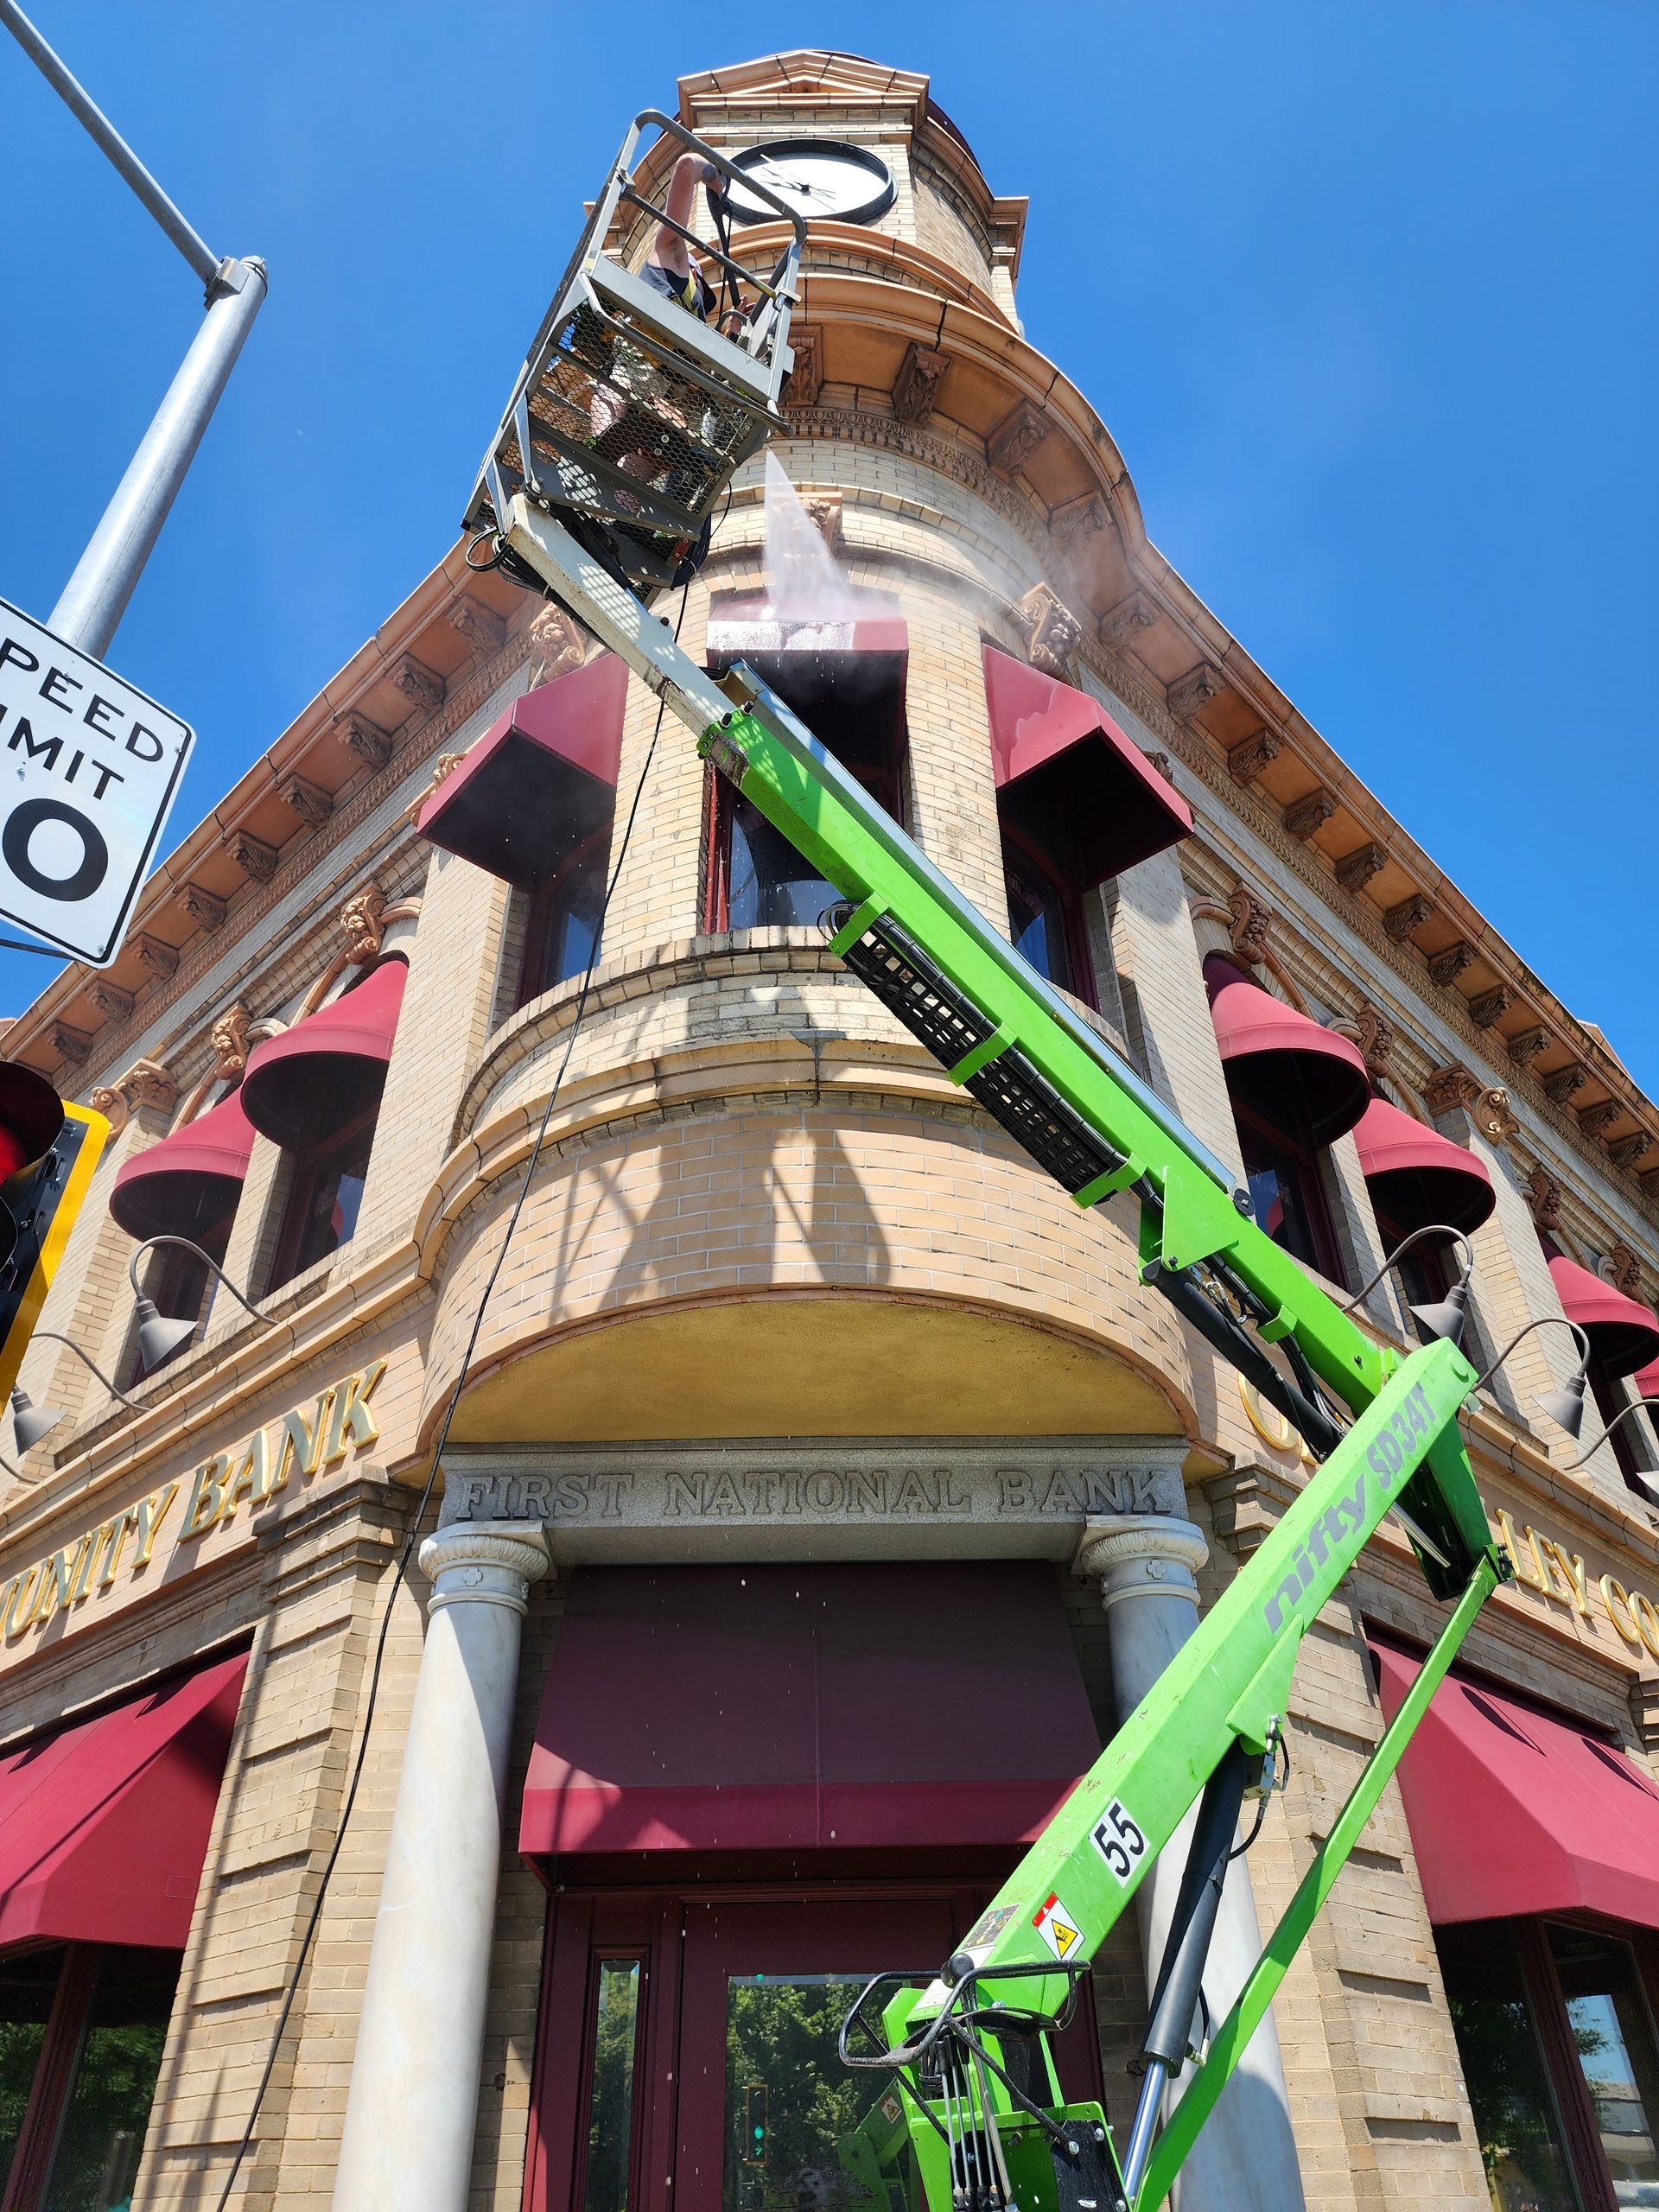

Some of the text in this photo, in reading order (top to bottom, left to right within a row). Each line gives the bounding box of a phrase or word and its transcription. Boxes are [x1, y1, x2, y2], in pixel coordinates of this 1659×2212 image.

[0, 638, 163, 762] PEED
[0, 1359, 388, 1640] UNITY BANK
[456, 1470, 1172, 1521] FIRST NATIONAL BANK
[1264, 1473, 1366, 1634] nifty
[1366, 1382, 1436, 1490] SD34T
[1479, 1496, 1659, 1659] LEY CO
[1094, 1802, 1144, 1878] 55
